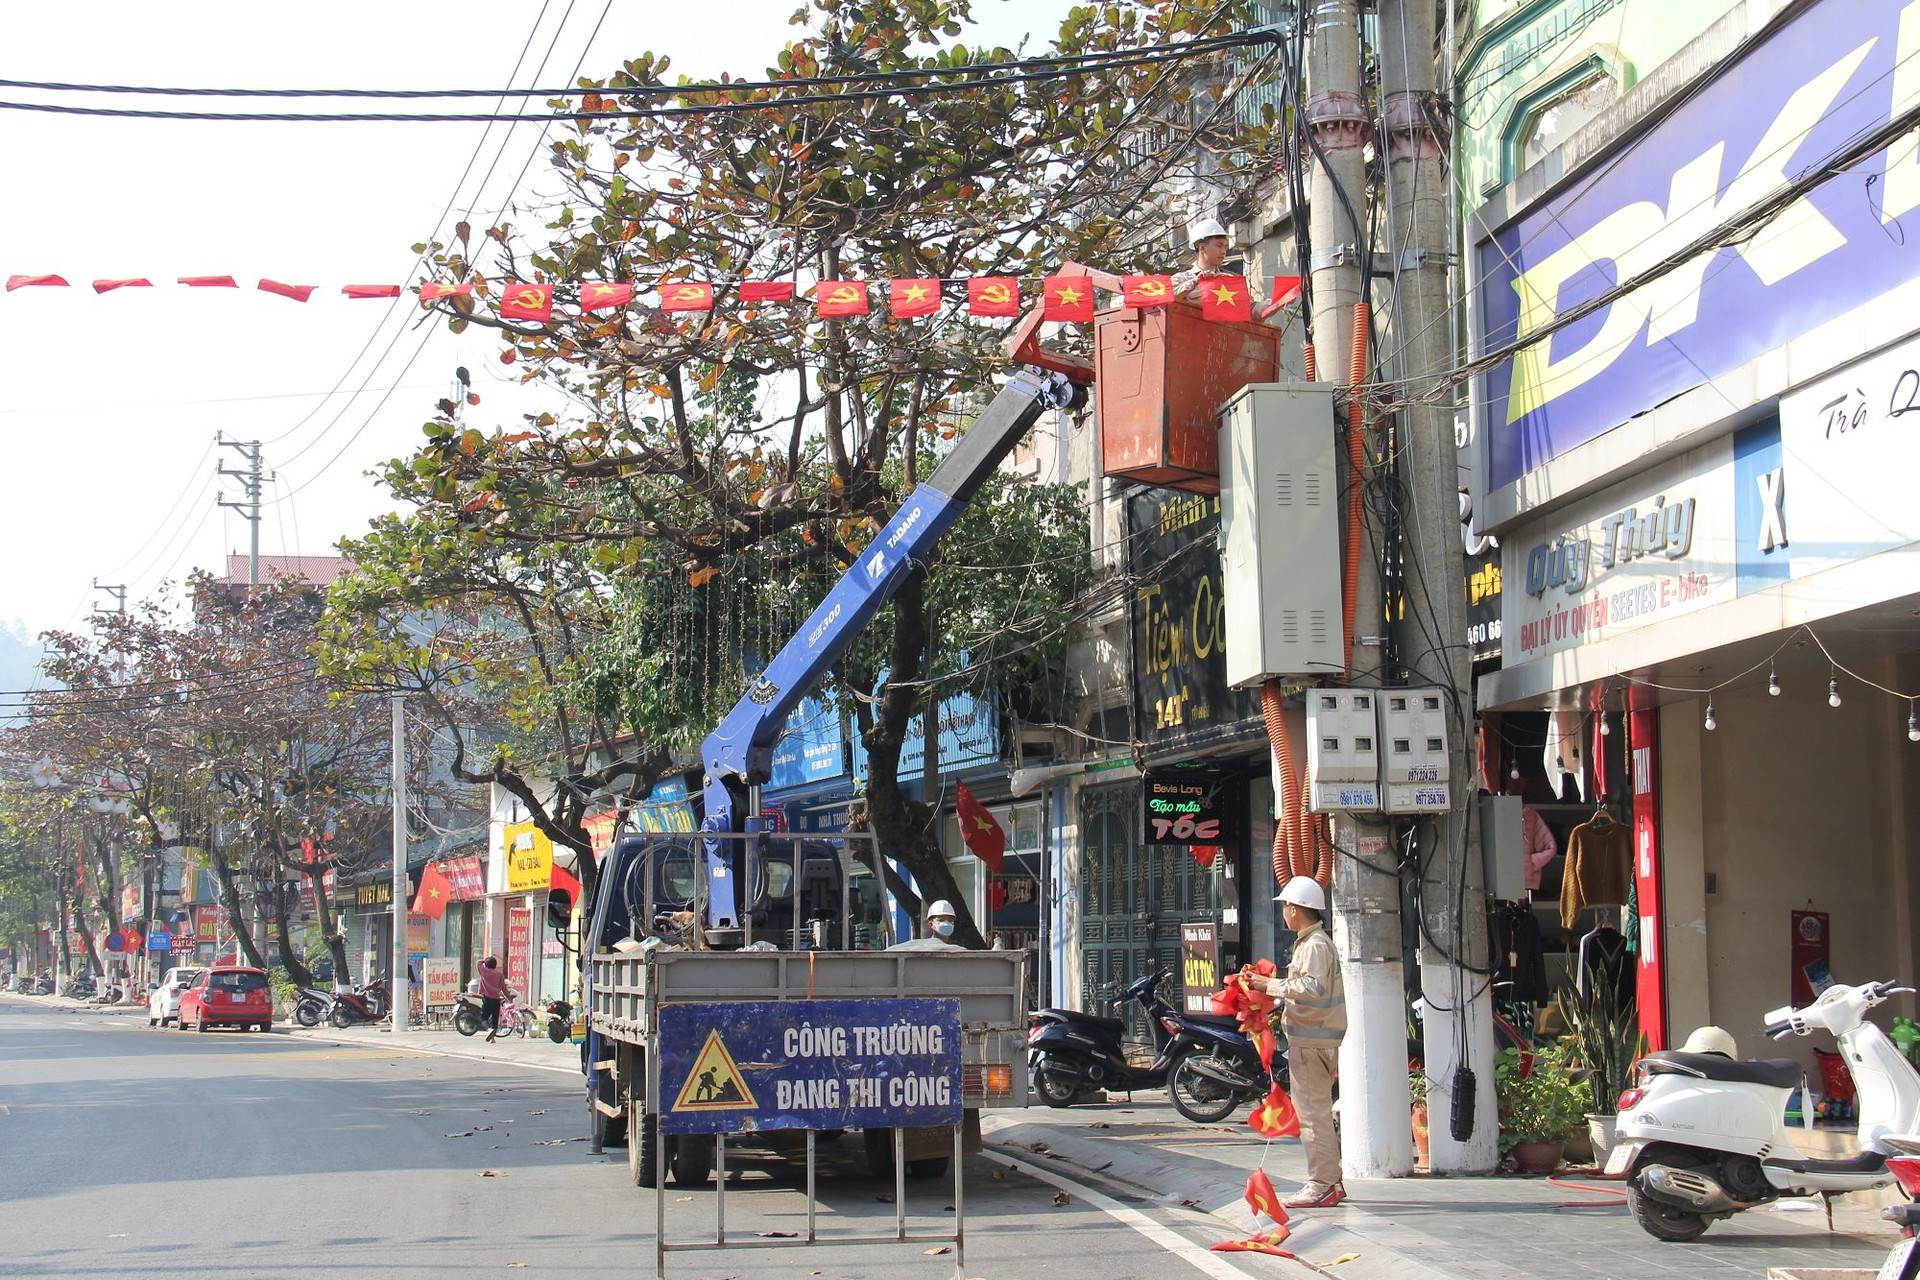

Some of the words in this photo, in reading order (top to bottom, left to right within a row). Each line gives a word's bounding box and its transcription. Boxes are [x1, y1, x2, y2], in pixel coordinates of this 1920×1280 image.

[1506, 2, 1920, 426] DK
[1819, 388, 1869, 439] Trà
[887, 507, 921, 549] TADANO
[1159, 496, 1207, 536] Minh
[1521, 621, 1538, 655] ĐẠI
[1540, 610, 1551, 646] LÝ
[1611, 581, 1657, 623] SEEYES
[1633, 747, 1650, 794] THAY
[1181, 785, 1202, 795] Long
[1150, 799, 1174, 813] Tạo
[1151, 813, 1220, 840] TÓC
[511, 913, 529, 927] BÁNH
[513, 931, 525, 942] BAO
[1184, 928, 1197, 941] Minh
[510, 943, 527, 956] BÁNH
[1184, 943, 1198, 987] CẮT
[1199, 951, 1214, 987] TÓC
[511, 973, 524, 987] CÁC
[430, 989, 444, 1001] GIÁC
[1187, 996, 1202, 1010] NAM
[784, 1021, 846, 1058] CÔNG
[852, 1019, 943, 1056] TRƯỜNG
[777, 1080, 840, 1110] ĐANG
[846, 1079, 881, 1107] THI
[891, 1072, 950, 1106] CÔNG
